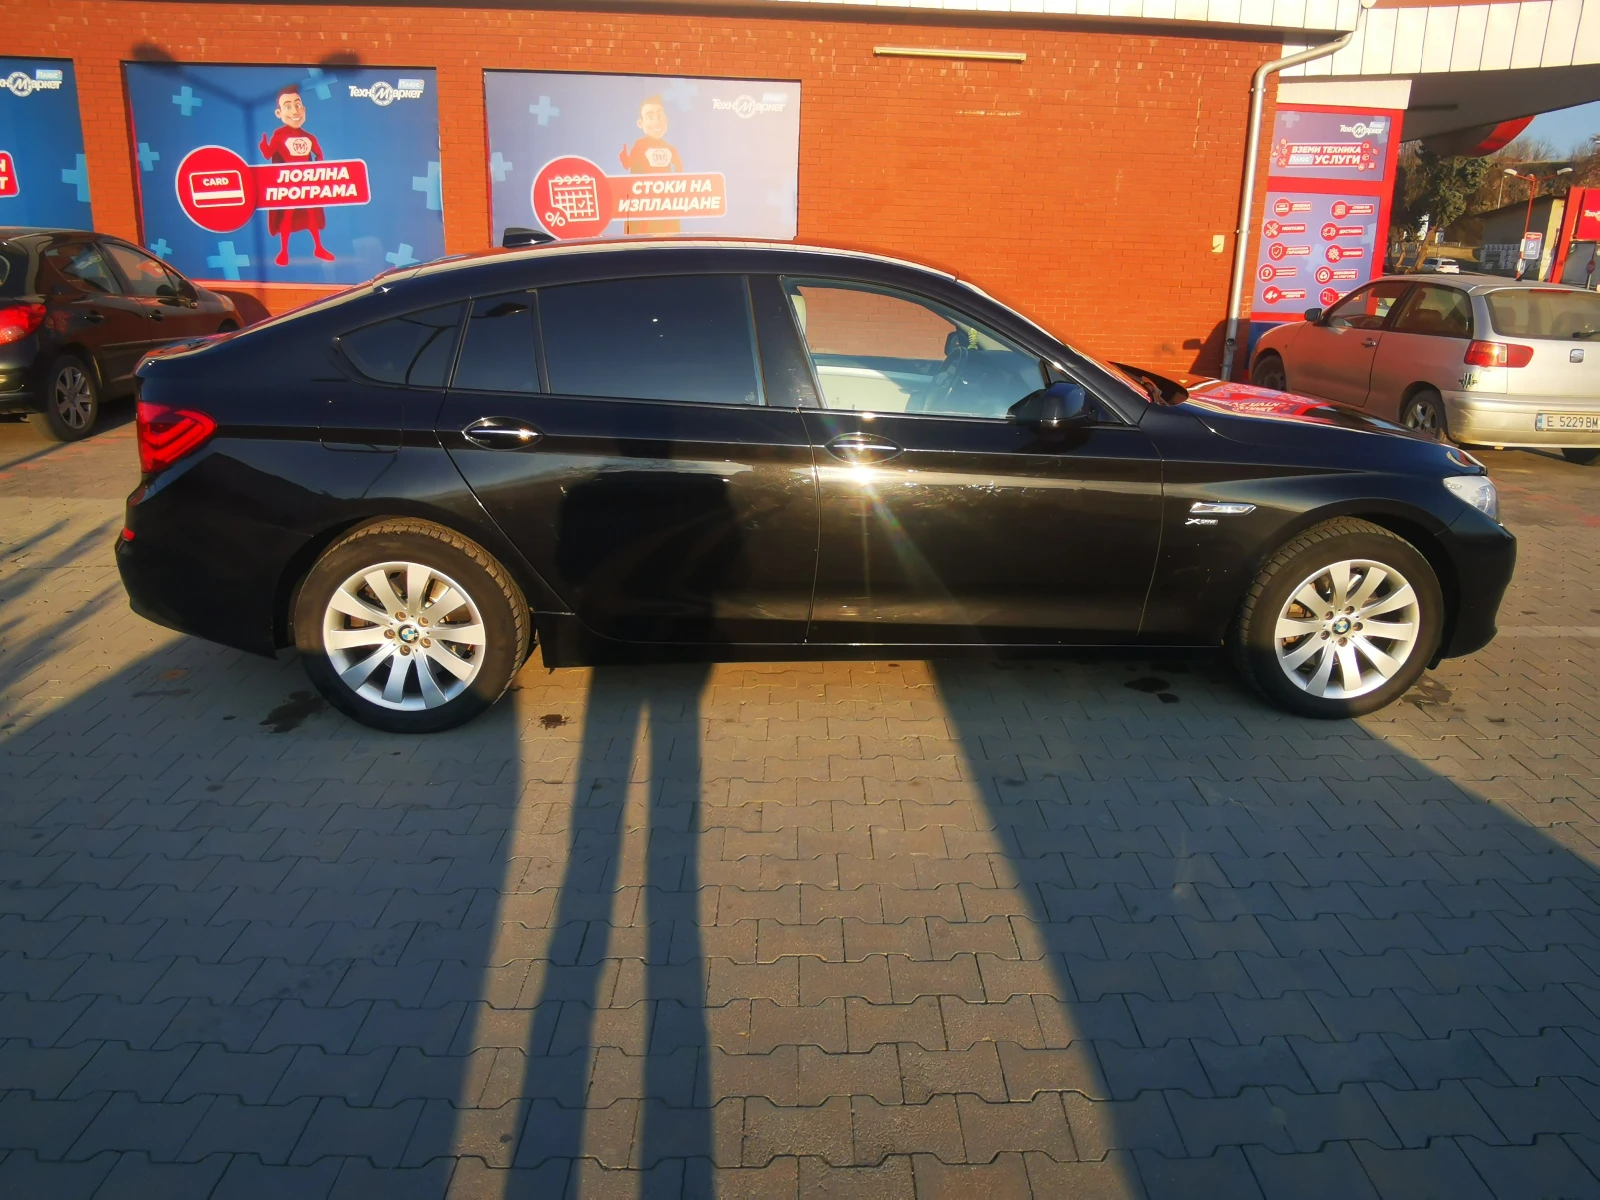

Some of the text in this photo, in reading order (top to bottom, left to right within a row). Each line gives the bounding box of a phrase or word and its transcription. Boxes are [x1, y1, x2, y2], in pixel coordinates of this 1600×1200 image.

[1291, 146, 1361, 154] ВЗЕМИ ТЕХНИКА
[1314, 155, 1360, 164] УСЛУГИ
[203, 177, 229, 187] CARD
[277, 167, 350, 183] ЛОЯЛНА
[266, 184, 358, 201] ПРОГРАМА
[632, 179, 712, 195] СТОКИ НА
[618, 196, 721, 213] ИЗПЛАЩАНЕ
